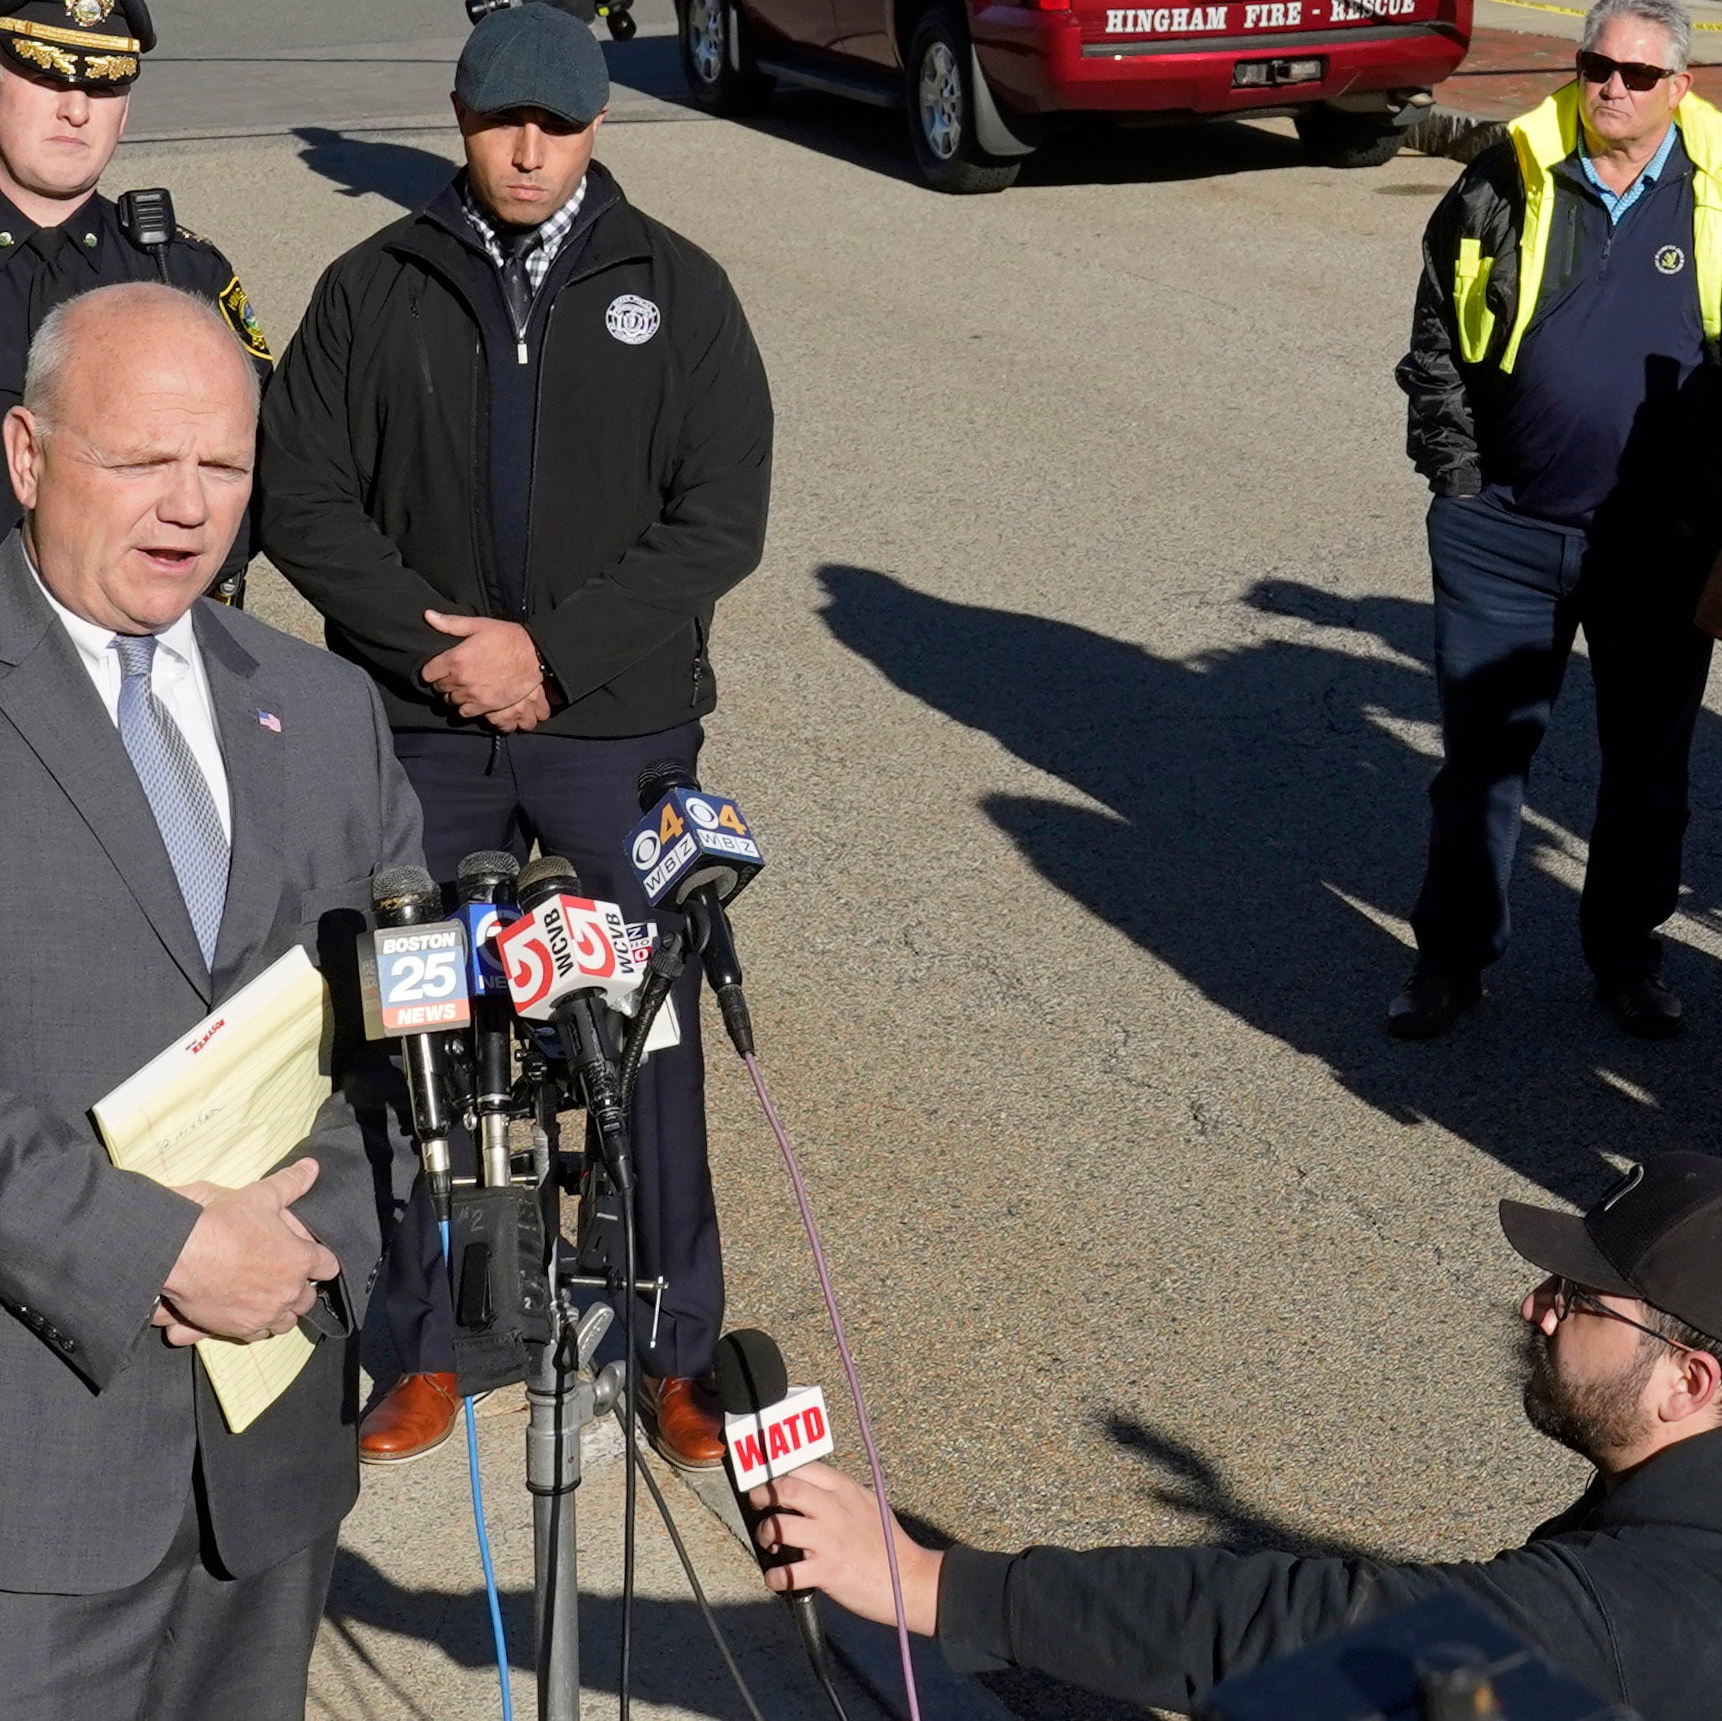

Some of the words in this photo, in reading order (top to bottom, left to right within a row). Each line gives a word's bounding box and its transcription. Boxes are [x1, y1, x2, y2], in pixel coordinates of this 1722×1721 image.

[1105, 6, 1227, 33] HINGHAM
[1243, 1, 1302, 28] FIRE
[658, 802, 684, 845] 4
[700, 829, 757, 854] WBZ
[717, 803, 747, 838] 4
[645, 839, 693, 893] WBZ
[383, 932, 456, 955] BOSTON
[543, 908, 575, 978] WCVB
[605, 913, 634, 974] WCVB
[388, 951, 457, 1003] 25
[397, 1003, 456, 1026] NEWS
[734, 1405, 827, 1473] WATD
